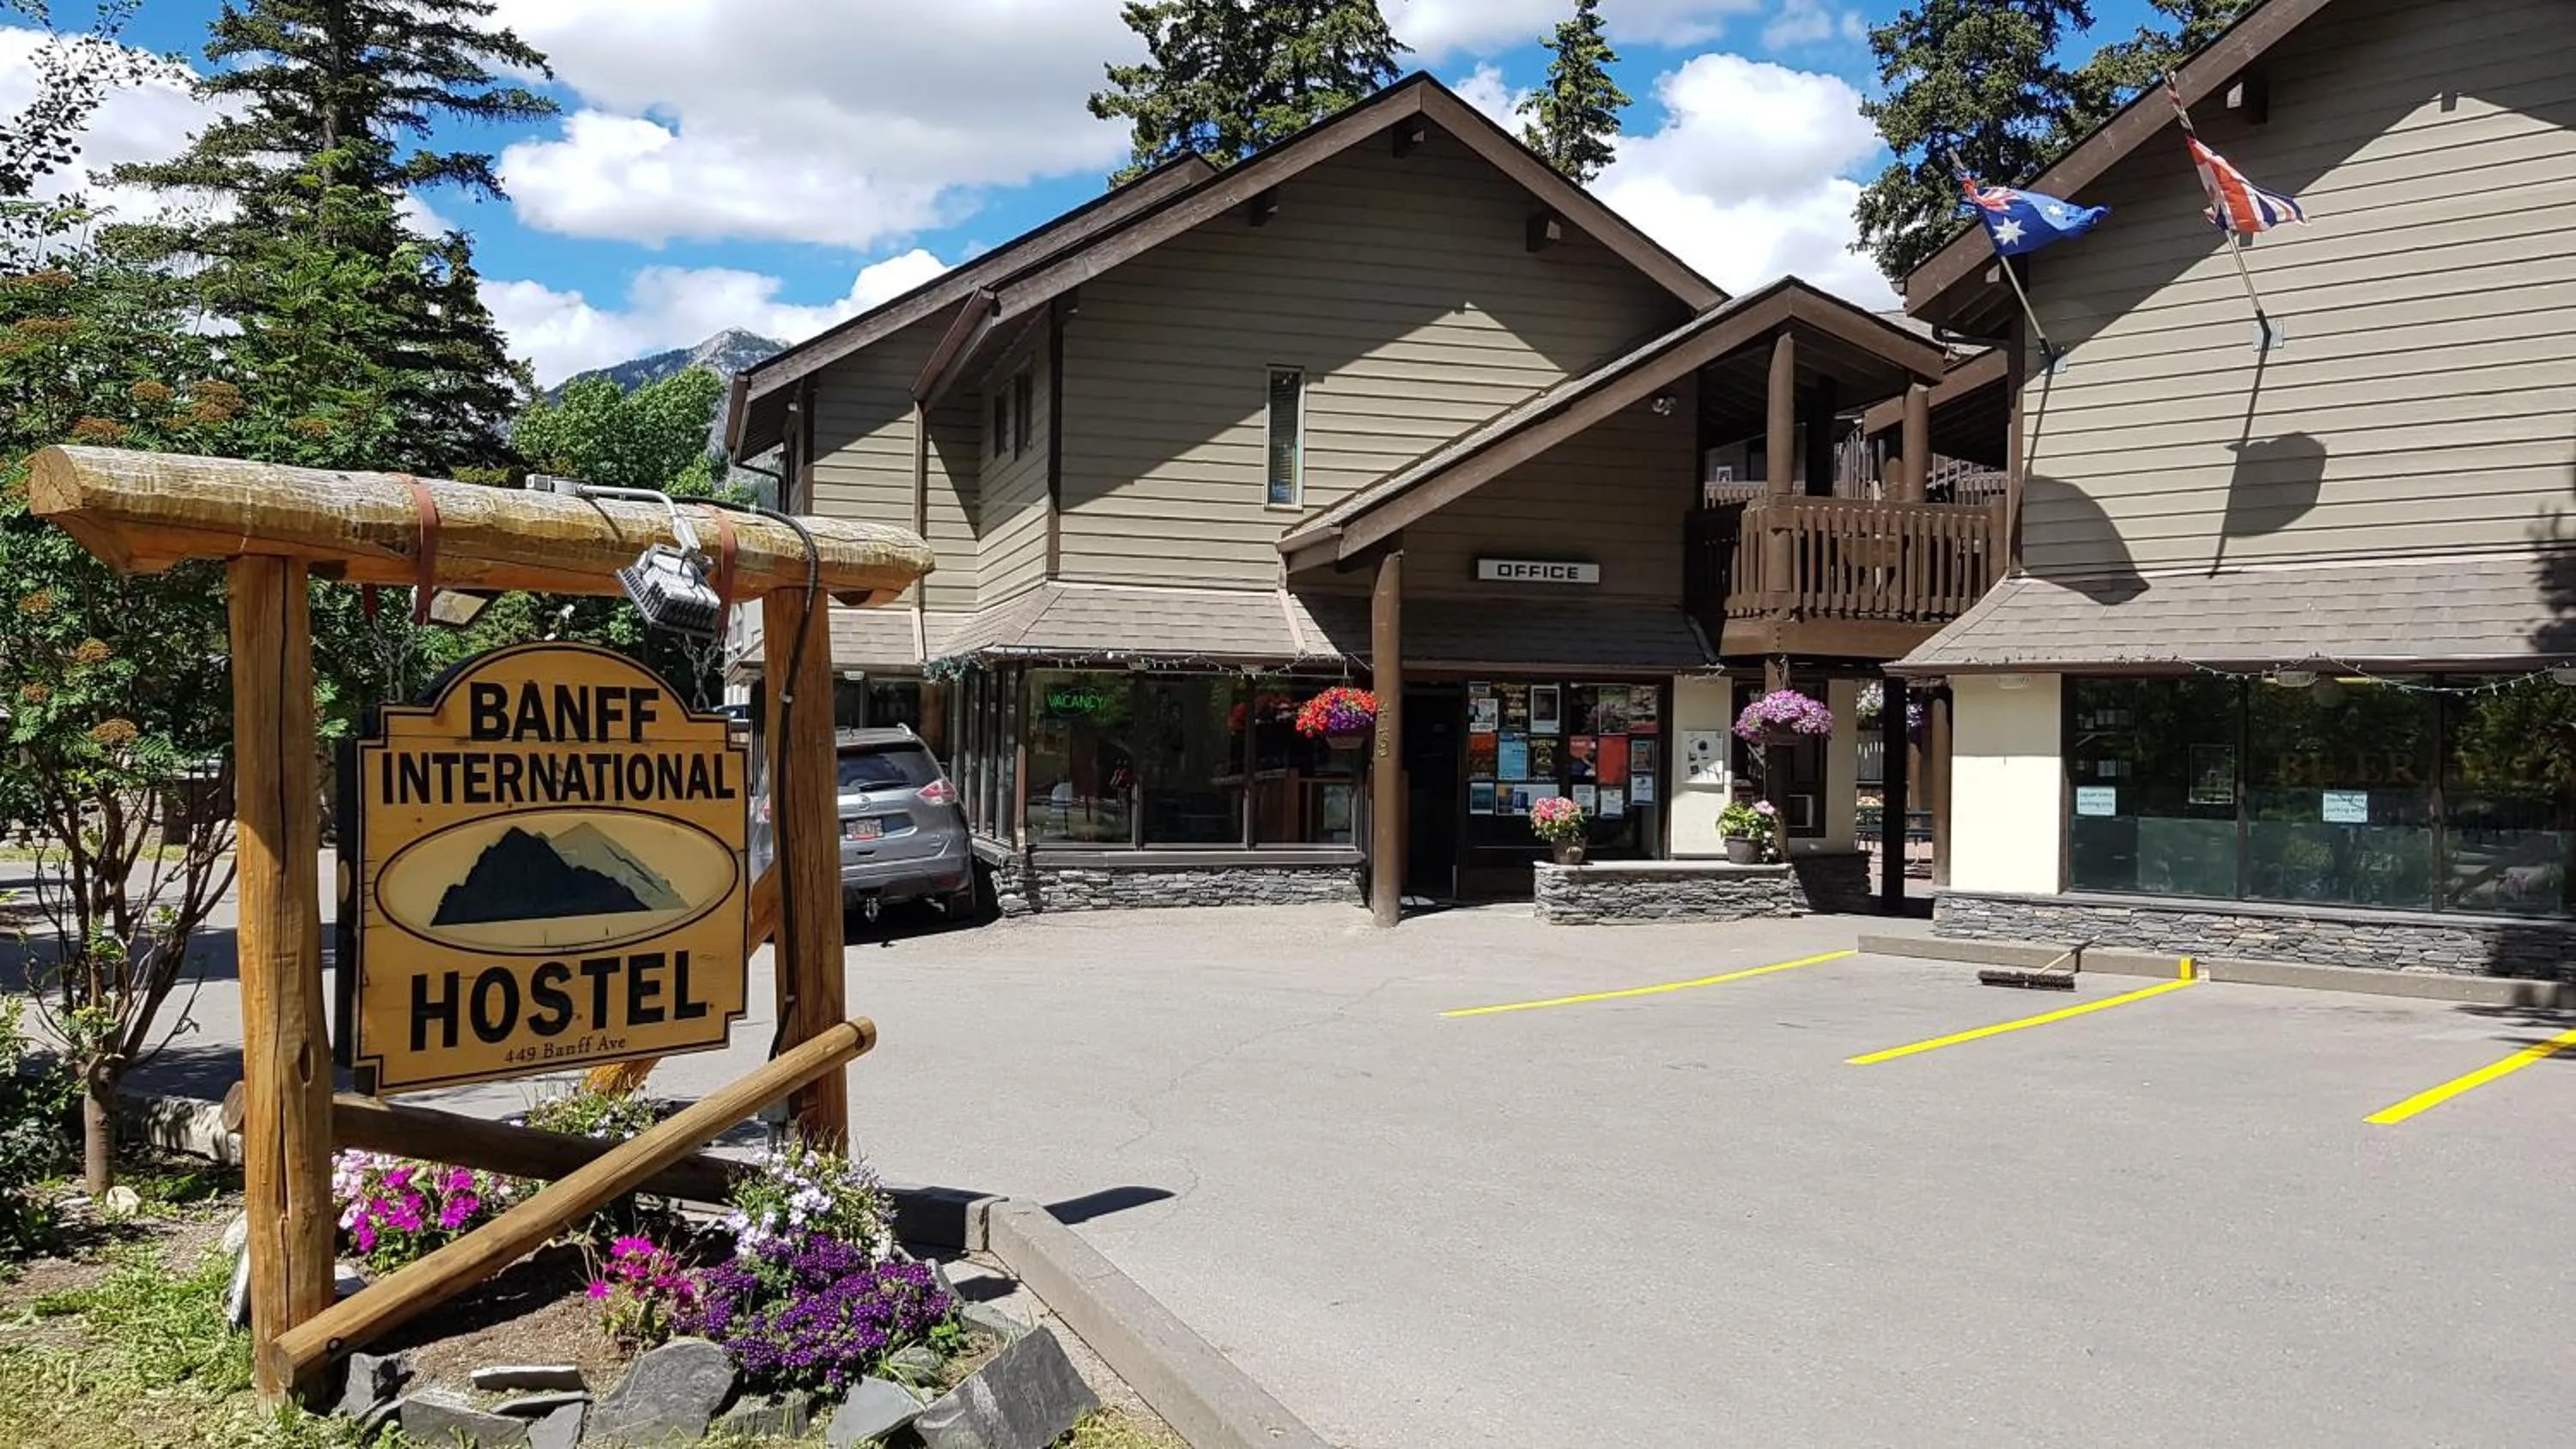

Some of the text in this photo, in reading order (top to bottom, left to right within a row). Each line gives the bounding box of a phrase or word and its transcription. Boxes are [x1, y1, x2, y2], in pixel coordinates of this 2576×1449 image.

[1497, 563, 1579, 579] OFFICE
[470, 681, 660, 743] BANFF
[1048, 694, 1103, 709] VACANCY
[382, 752, 736, 804] INTERNATIONAL
[410, 949, 708, 1052] HOSTEL
[503, 1035, 627, 1064] 449 Banff Ave
